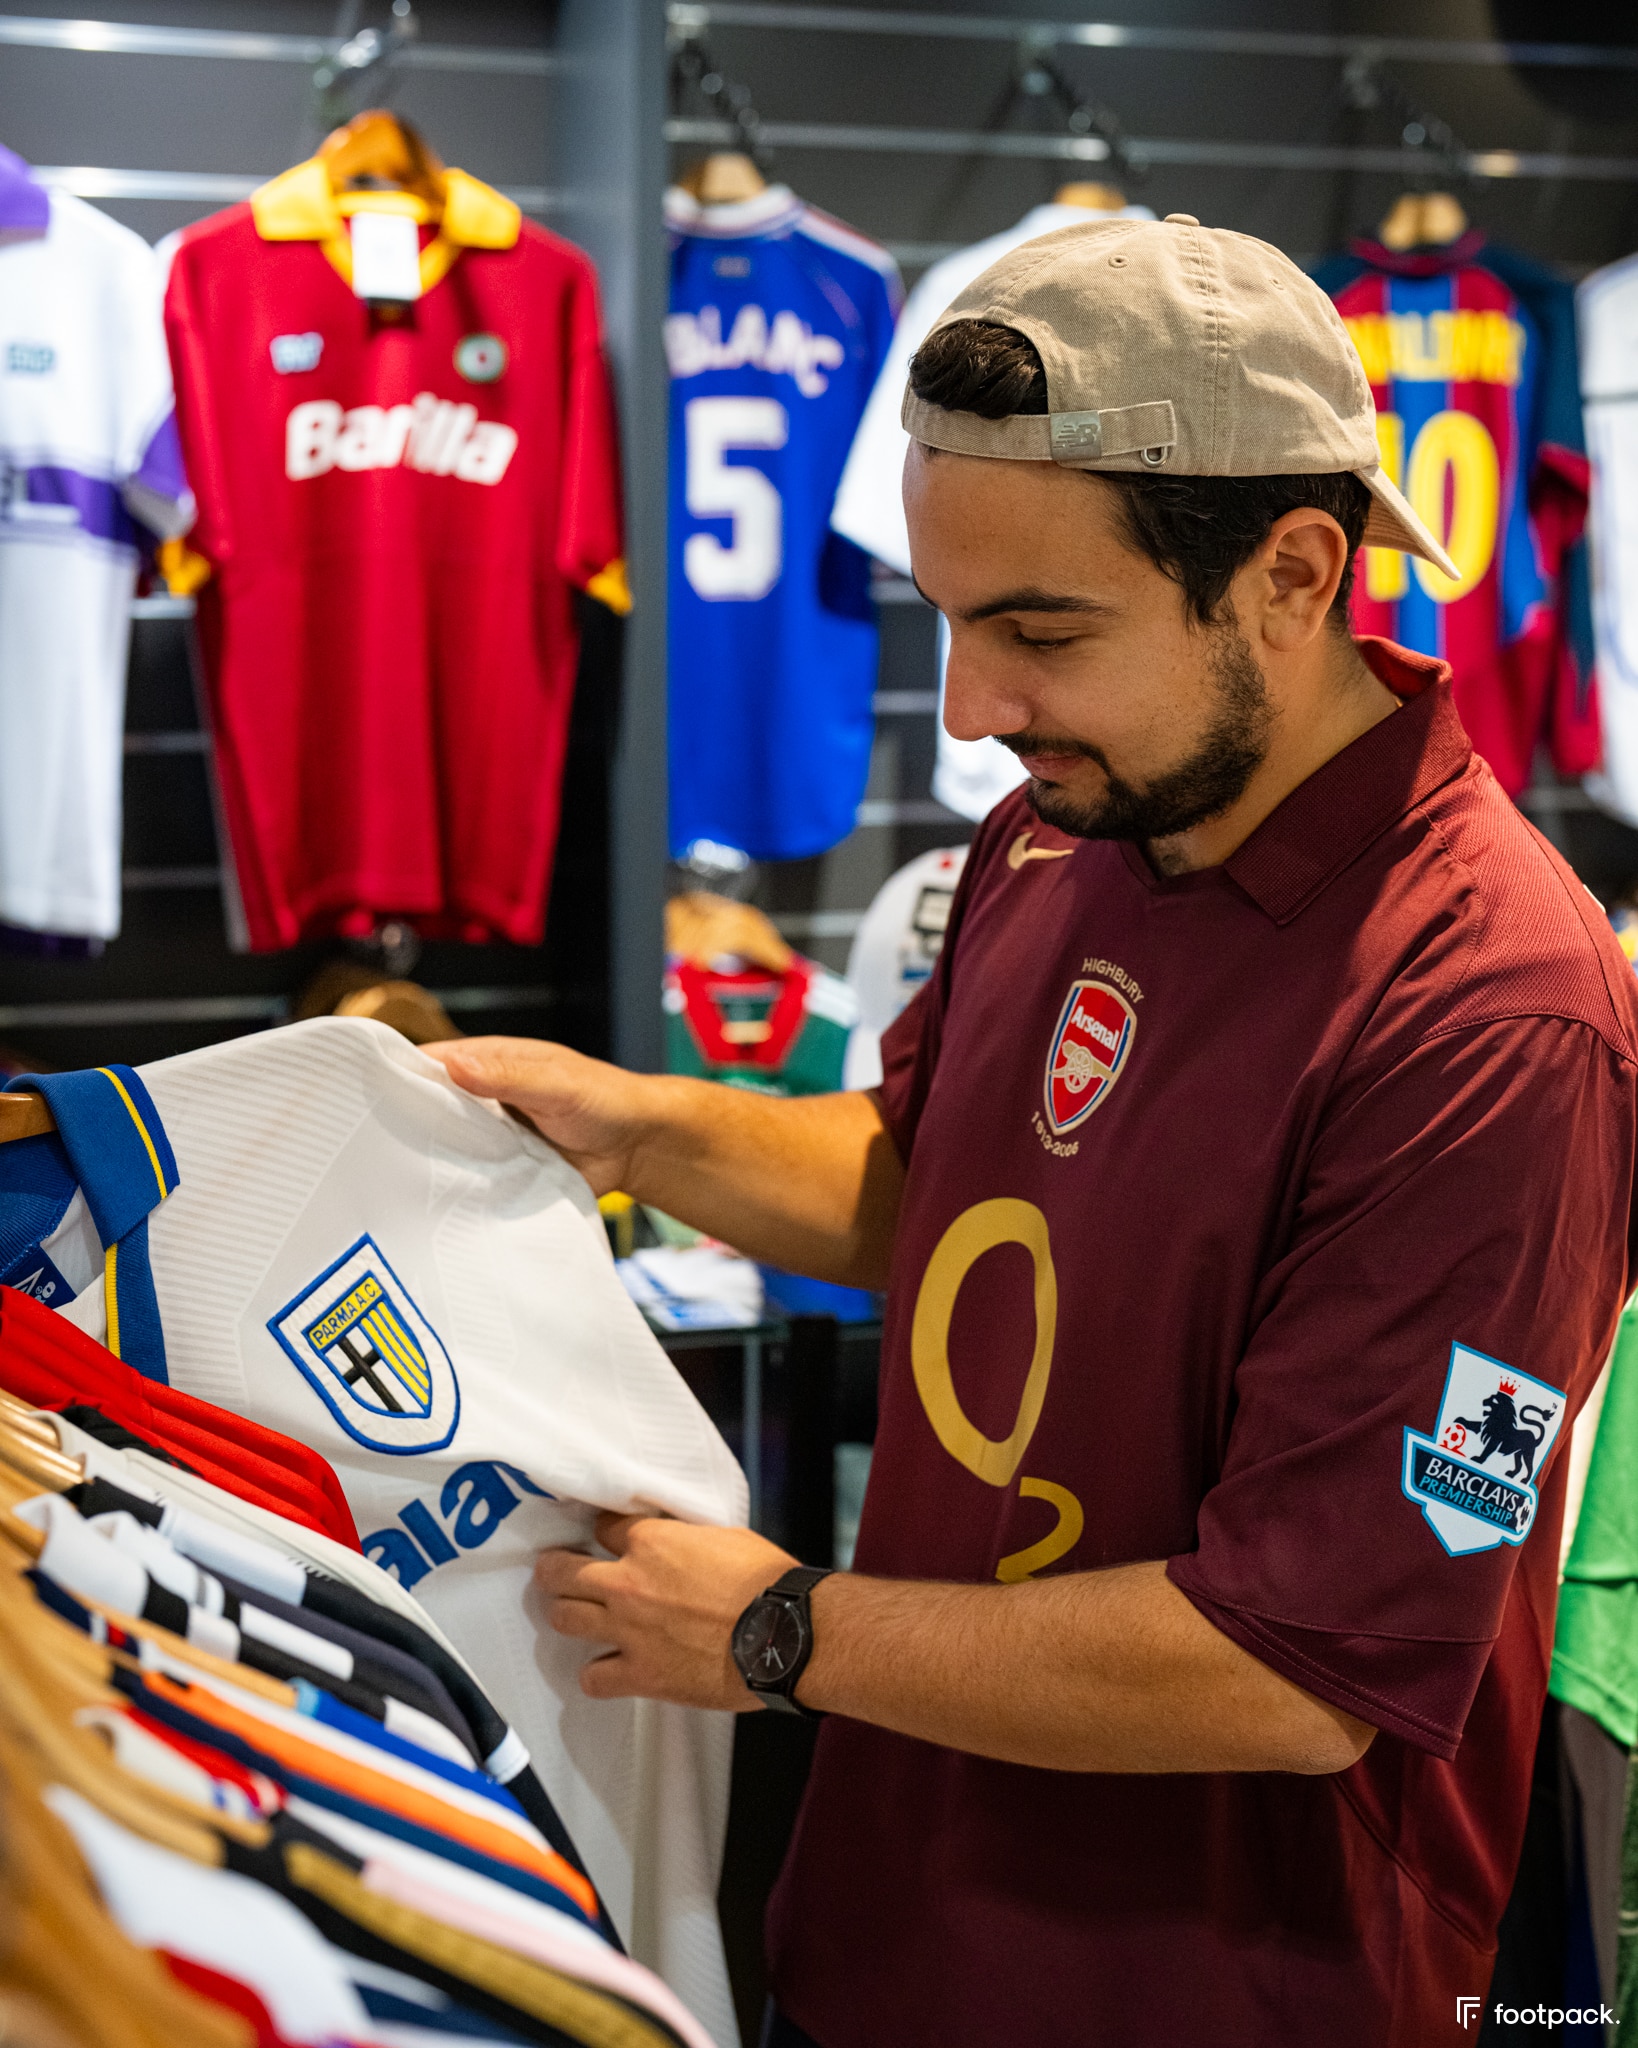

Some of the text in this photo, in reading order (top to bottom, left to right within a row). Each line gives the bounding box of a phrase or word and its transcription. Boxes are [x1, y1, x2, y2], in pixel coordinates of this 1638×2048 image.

[285, 393, 518, 486] Barilla
[684, 397, 789, 602] 5
[1366, 411, 1500, 603] 10
[1081, 958, 1144, 1004] HIGHBURY
[1070, 1005, 1120, 1052] Arsenal
[312, 1301, 358, 1346] PARMA
[1419, 1475, 1513, 1524] PREMIERSHIP
[1425, 1457, 1520, 1512] BARCLAYS
